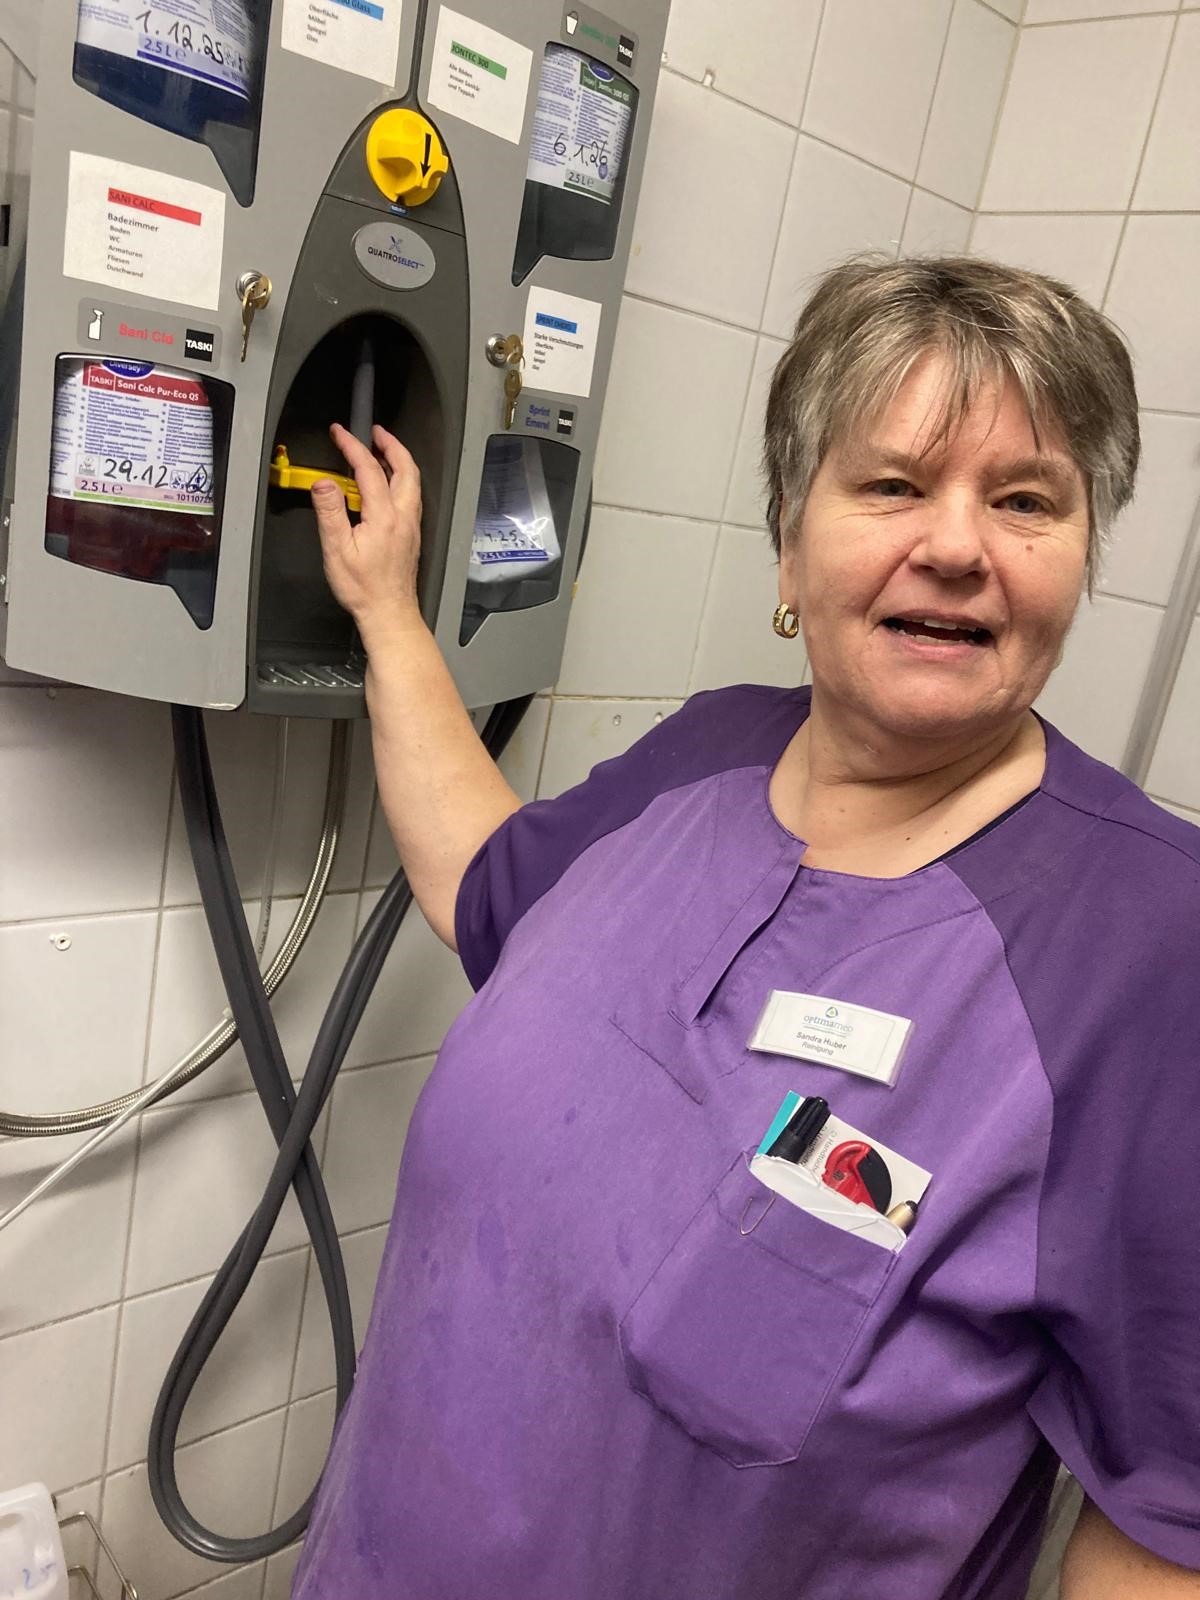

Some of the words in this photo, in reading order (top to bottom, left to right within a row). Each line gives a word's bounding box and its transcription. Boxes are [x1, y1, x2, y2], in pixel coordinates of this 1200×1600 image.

[452, 44, 476, 63] JONTEC
[109, 191, 131, 205] SANI
[133, 196, 155, 212] CALC
[107, 212, 160, 233] Badezimmer
[110, 225, 131, 236] Boden
[109, 235, 121, 244] WC
[107, 254, 130, 265] Fliesen
[108, 245, 143, 259] Armaturen
[106, 264, 144, 279] Duschwand
[118, 323, 148, 339] Sani
[185, 339, 213, 352] TASKI
[91, 375, 113, 386] TASKI
[118, 380, 137, 391] Sani
[138, 383, 156, 394] Calc
[157, 386, 188, 399] Pur-Eco
[188, 392, 200, 402] QS
[81, 480, 98, 493] 2.5
[102, 482, 111, 494] L
[796, 1031, 823, 1044] Sandra
[824, 1037, 847, 1051] Huber
[802, 1041, 834, 1056] Reinigung
